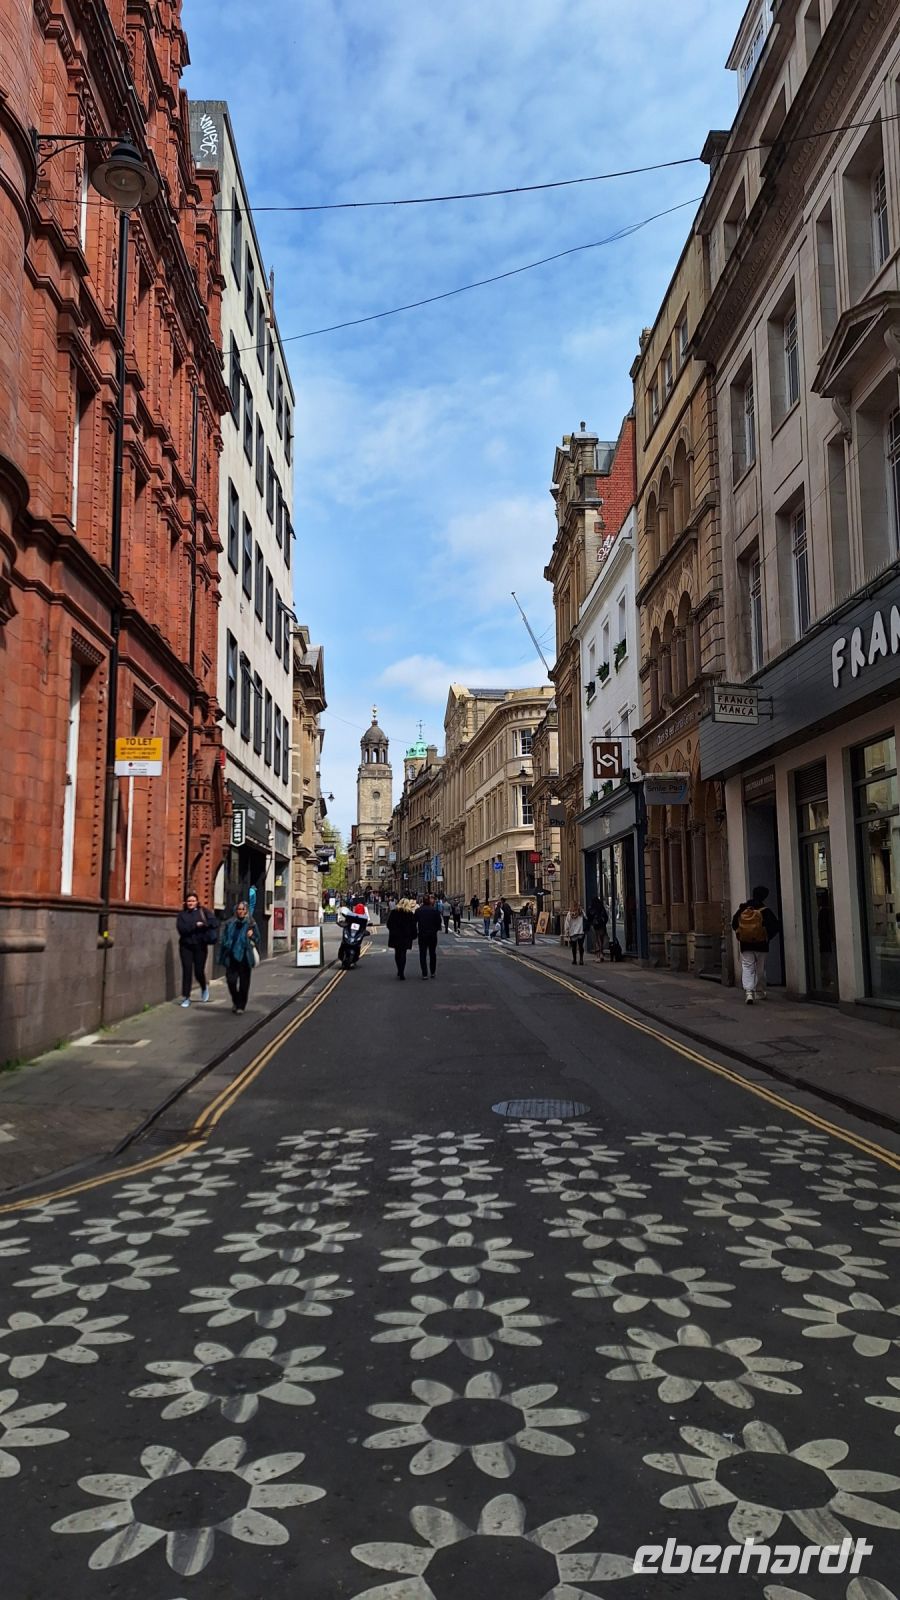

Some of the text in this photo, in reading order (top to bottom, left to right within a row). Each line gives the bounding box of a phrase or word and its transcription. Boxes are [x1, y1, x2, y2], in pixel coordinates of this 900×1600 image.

[717, 695, 754, 705] FRANCO
[719, 705, 754, 716] MANCA
[125, 737, 152, 746] TO LET
[233, 812, 242, 842] HONEST
[549, 818, 566, 826] Pho
